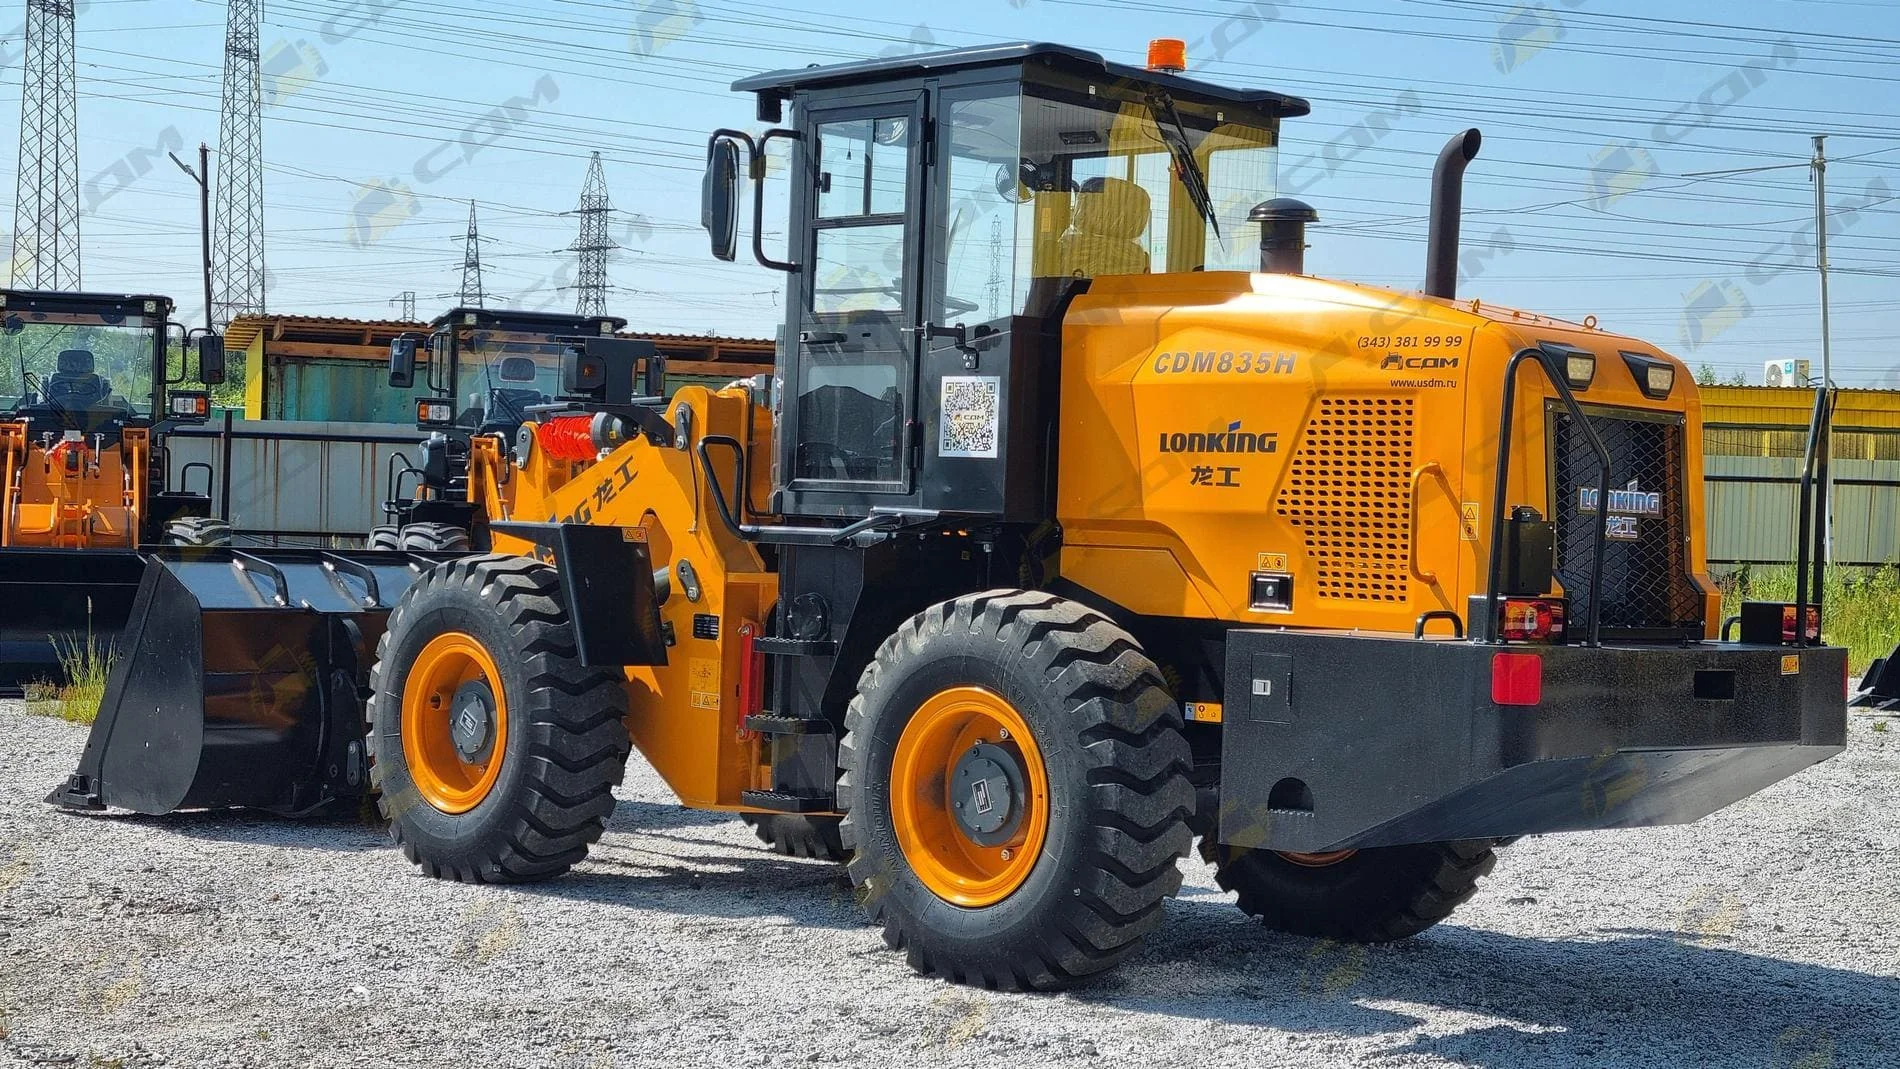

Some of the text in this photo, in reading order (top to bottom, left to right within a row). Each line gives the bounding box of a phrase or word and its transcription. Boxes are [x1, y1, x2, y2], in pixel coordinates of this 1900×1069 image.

[1357, 335, 1463, 349] (343) 381 99 99
[1154, 351, 1297, 374] CDM835H
[1390, 378, 1457, 389] www.usdm.ru
[1189, 465, 1241, 488] 龙工
